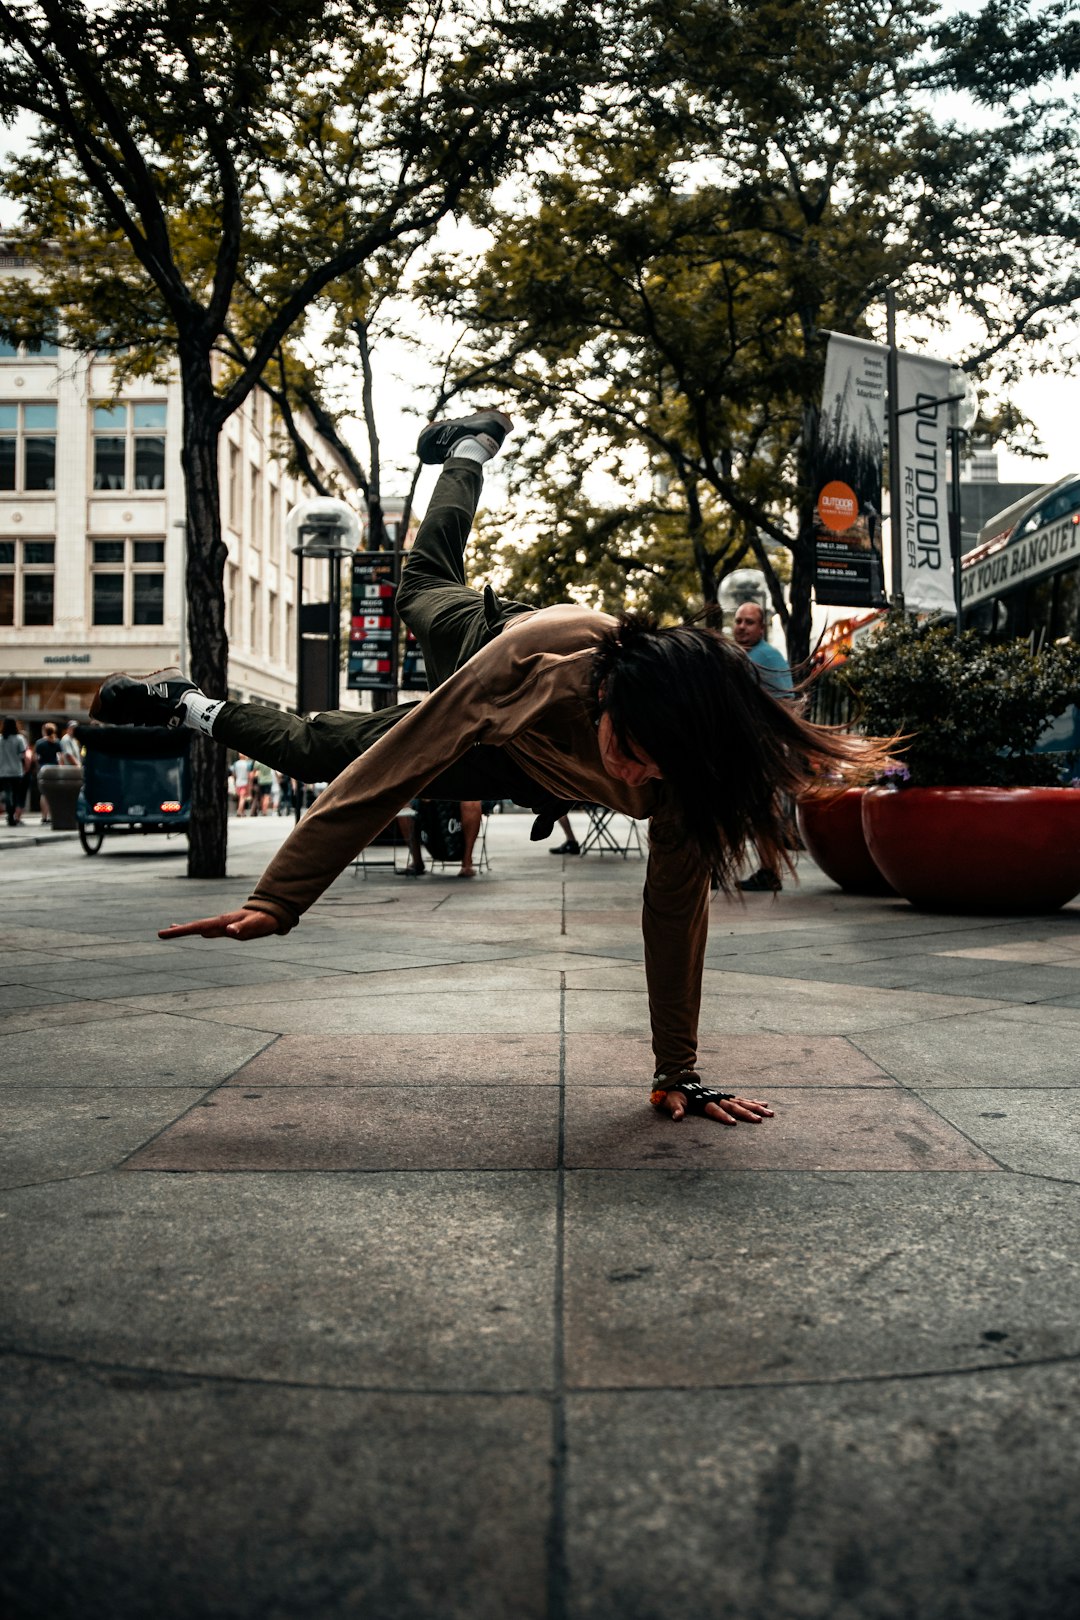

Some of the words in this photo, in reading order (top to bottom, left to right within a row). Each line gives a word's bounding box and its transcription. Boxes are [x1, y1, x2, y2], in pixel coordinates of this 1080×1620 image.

[822, 496, 853, 509] OUTDOOR
[905, 466, 917, 569] RETAILER
[915, 392, 942, 571] OUTDOOR
[961, 570, 976, 600] OK
[977, 555, 1009, 592] YOUR
[1010, 522, 1078, 577] BANQUET
